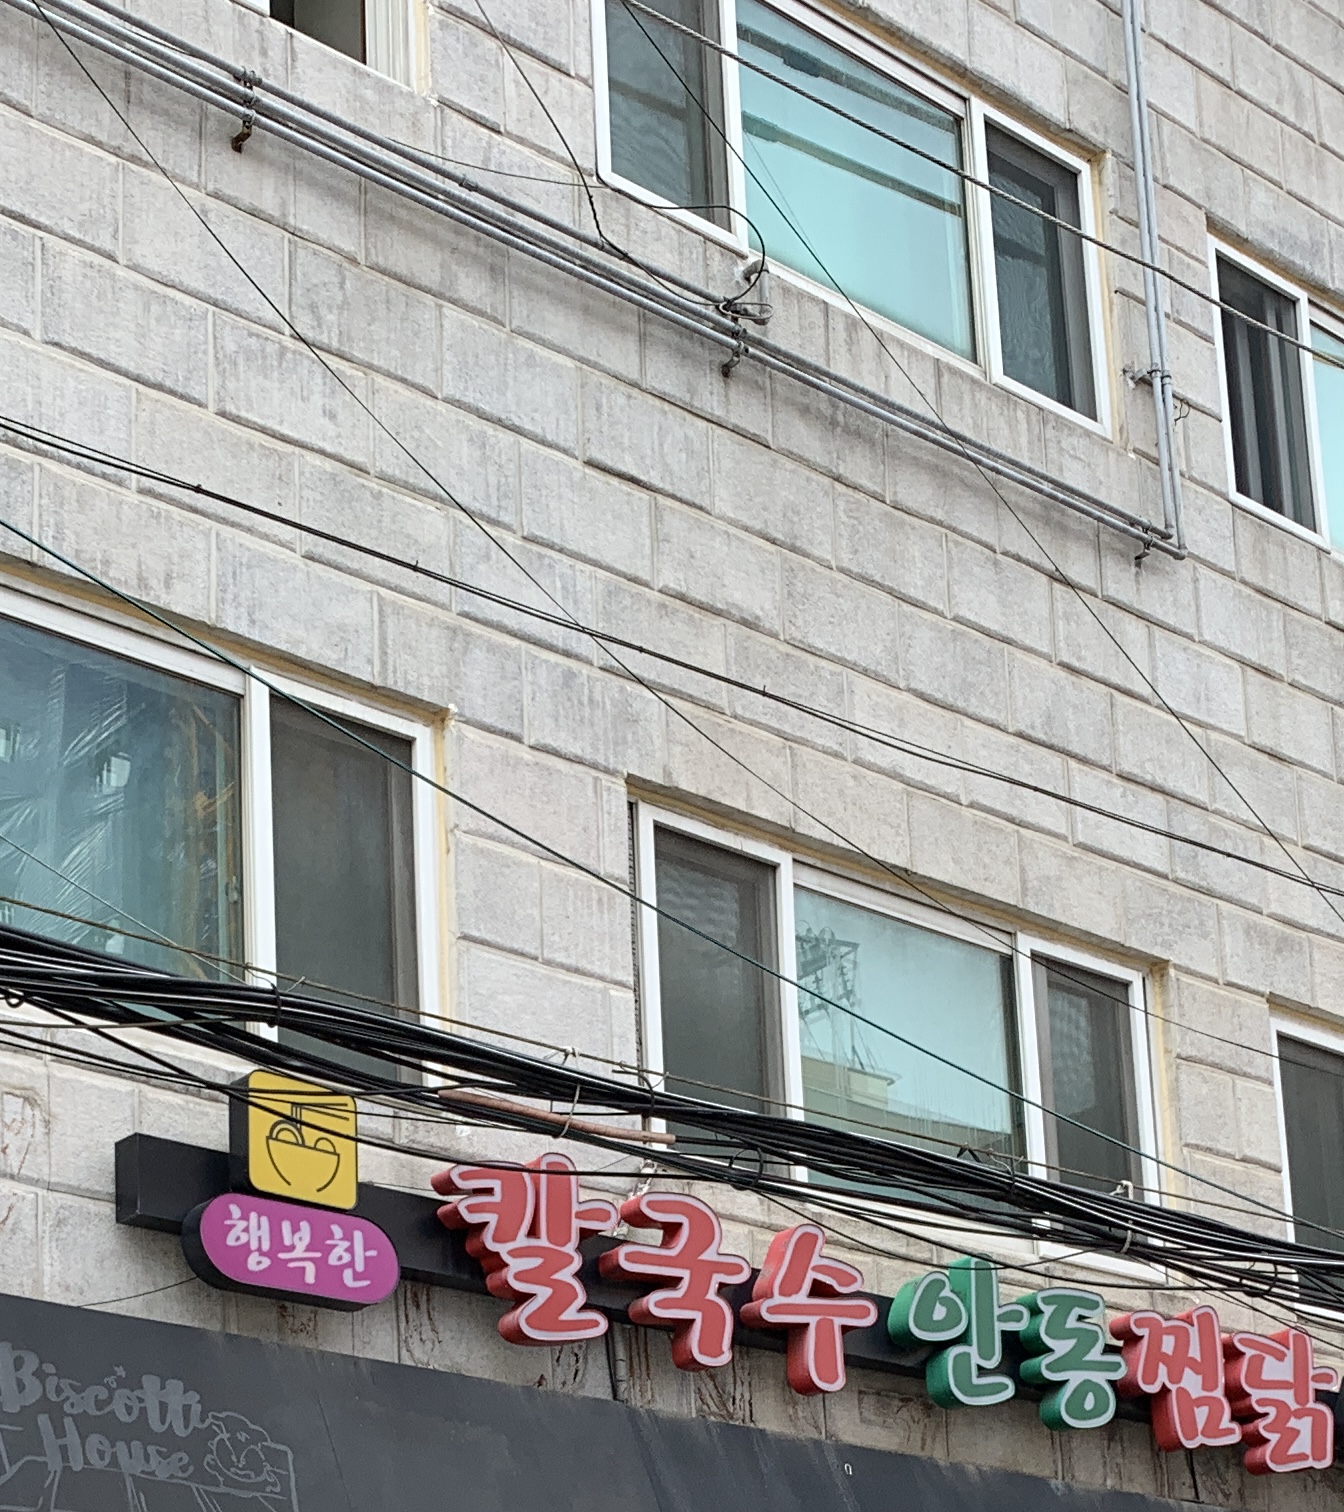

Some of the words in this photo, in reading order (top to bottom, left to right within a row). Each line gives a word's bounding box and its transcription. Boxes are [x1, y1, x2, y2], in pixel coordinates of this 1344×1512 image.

[223, 1202, 377, 1289] 행복한
[432, 1152, 878, 1396] 칼국수
[890, 1255, 1339, 1475] 안동찜닭
[37, 1414, 194, 1479] House
